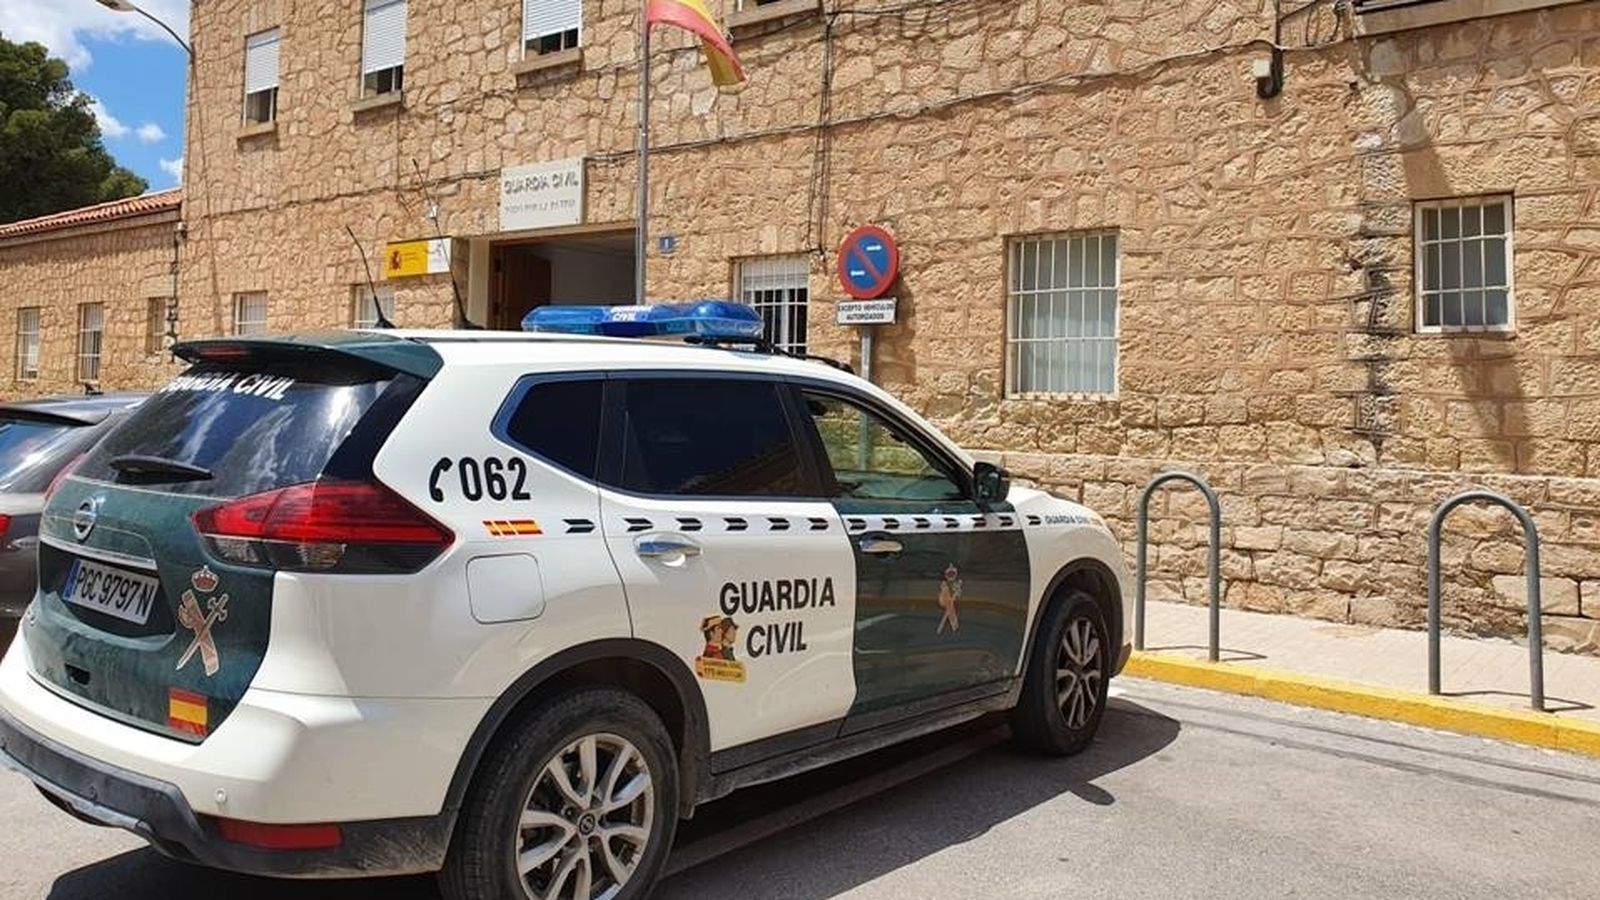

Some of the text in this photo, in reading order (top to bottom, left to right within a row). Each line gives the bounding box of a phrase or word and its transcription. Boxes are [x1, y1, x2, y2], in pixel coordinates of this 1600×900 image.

[504, 170, 579, 195] GUARDIA CIVIL
[233, 373, 295, 400] CIVIL
[458, 457, 532, 502] 062
[719, 576, 836, 616] GUARDIA
[746, 620, 807, 658] CIVIL
